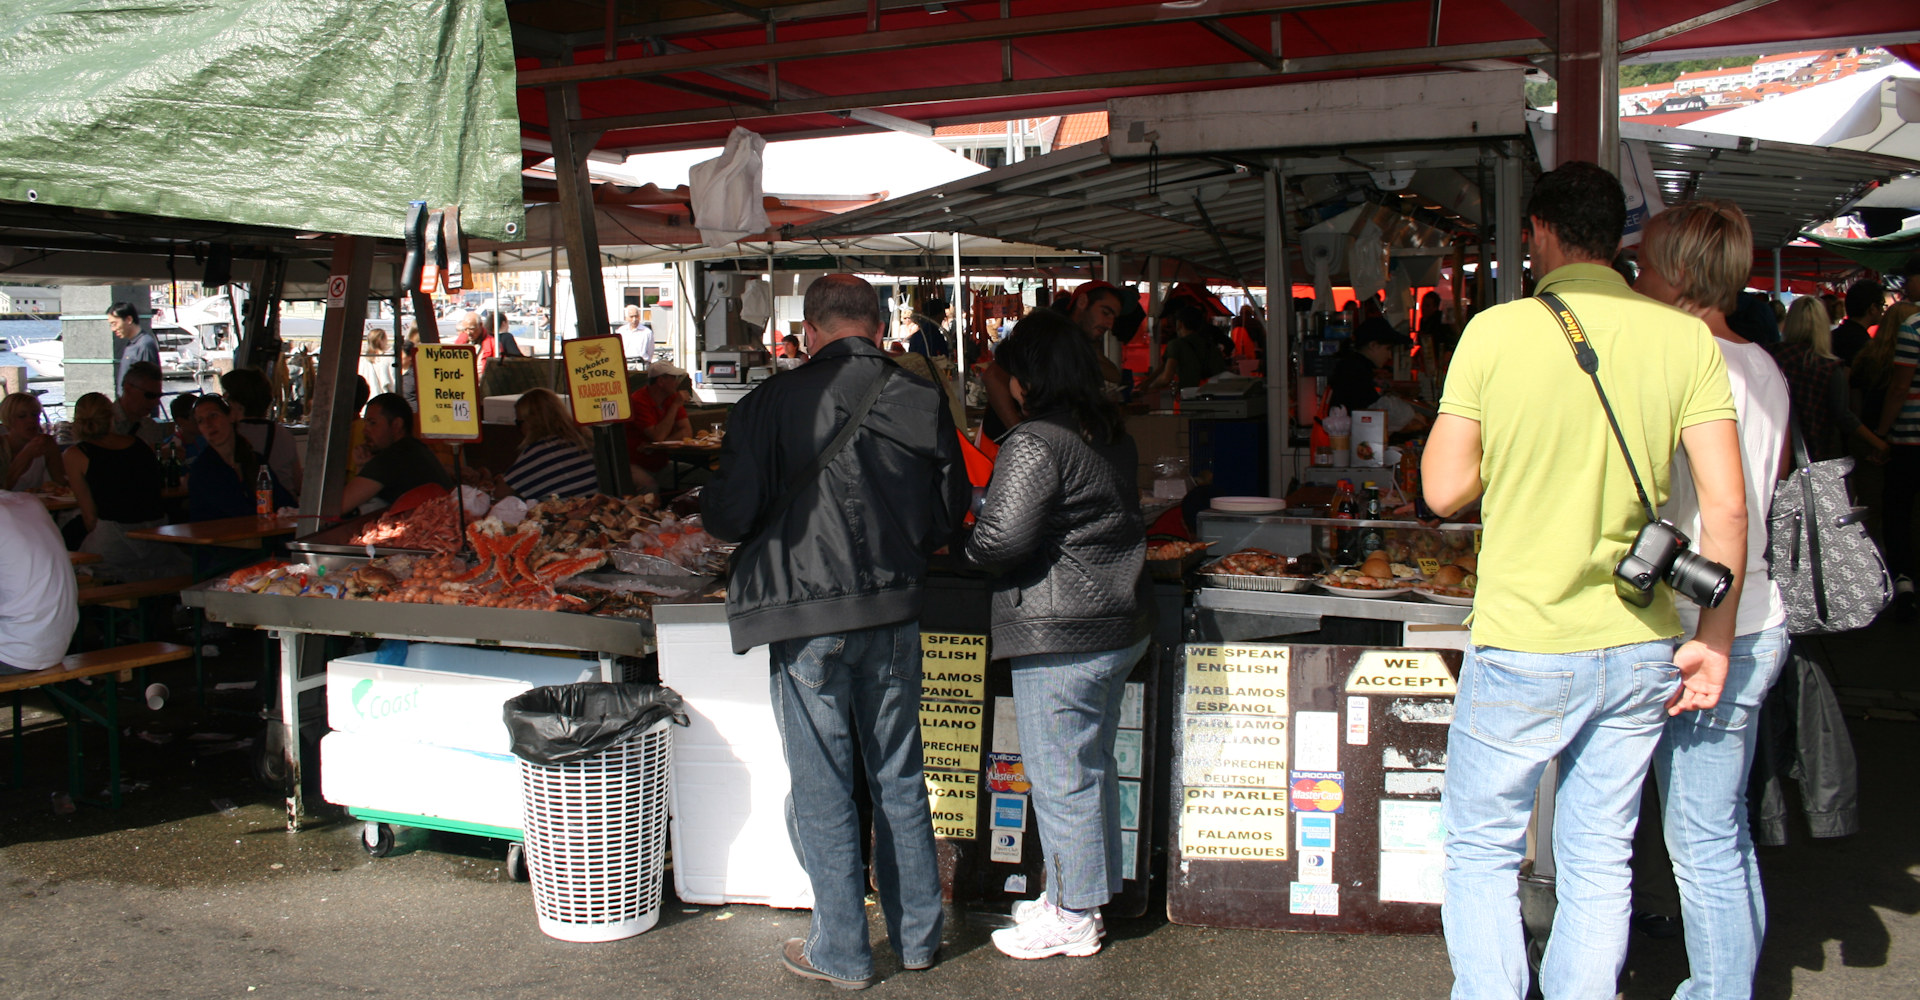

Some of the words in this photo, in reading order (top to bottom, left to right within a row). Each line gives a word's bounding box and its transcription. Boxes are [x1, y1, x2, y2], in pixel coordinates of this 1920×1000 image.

[426, 347, 469, 361] Nykokte
[575, 357, 610, 375] Nykokte
[434, 368, 464, 382] Fjord-
[582, 369, 616, 381] STORE
[435, 388, 465, 400] Reker
[603, 402, 616, 417] 110
[928, 635, 984, 646] SPEAK
[1189, 647, 1218, 657] WE
[1224, 648, 1285, 659] SPEAK
[1197, 663, 1278, 674] ENGLISH
[1384, 659, 1419, 669] WE
[1355, 676, 1448, 687] ACCEPT
[921, 687, 973, 698] PANOL
[1188, 685, 1285, 698] HABLAMOS
[370, 686, 419, 719] Coast
[1196, 701, 1276, 714] ESPANOL
[922, 718, 976, 730] LIANO
[923, 741, 979, 753] PRECHEN
[1203, 773, 1265, 785] DEUTSCH
[1292, 771, 1342, 780] EUROCARD
[1187, 789, 1215, 798] ON
[1223, 790, 1284, 801] PARLE
[1292, 789, 1342, 800] MasterCard
[1186, 805, 1285, 817] FRANCAIS
[1197, 829, 1273, 841] FALAMOS
[1185, 845, 1285, 857] PORTUGUES
